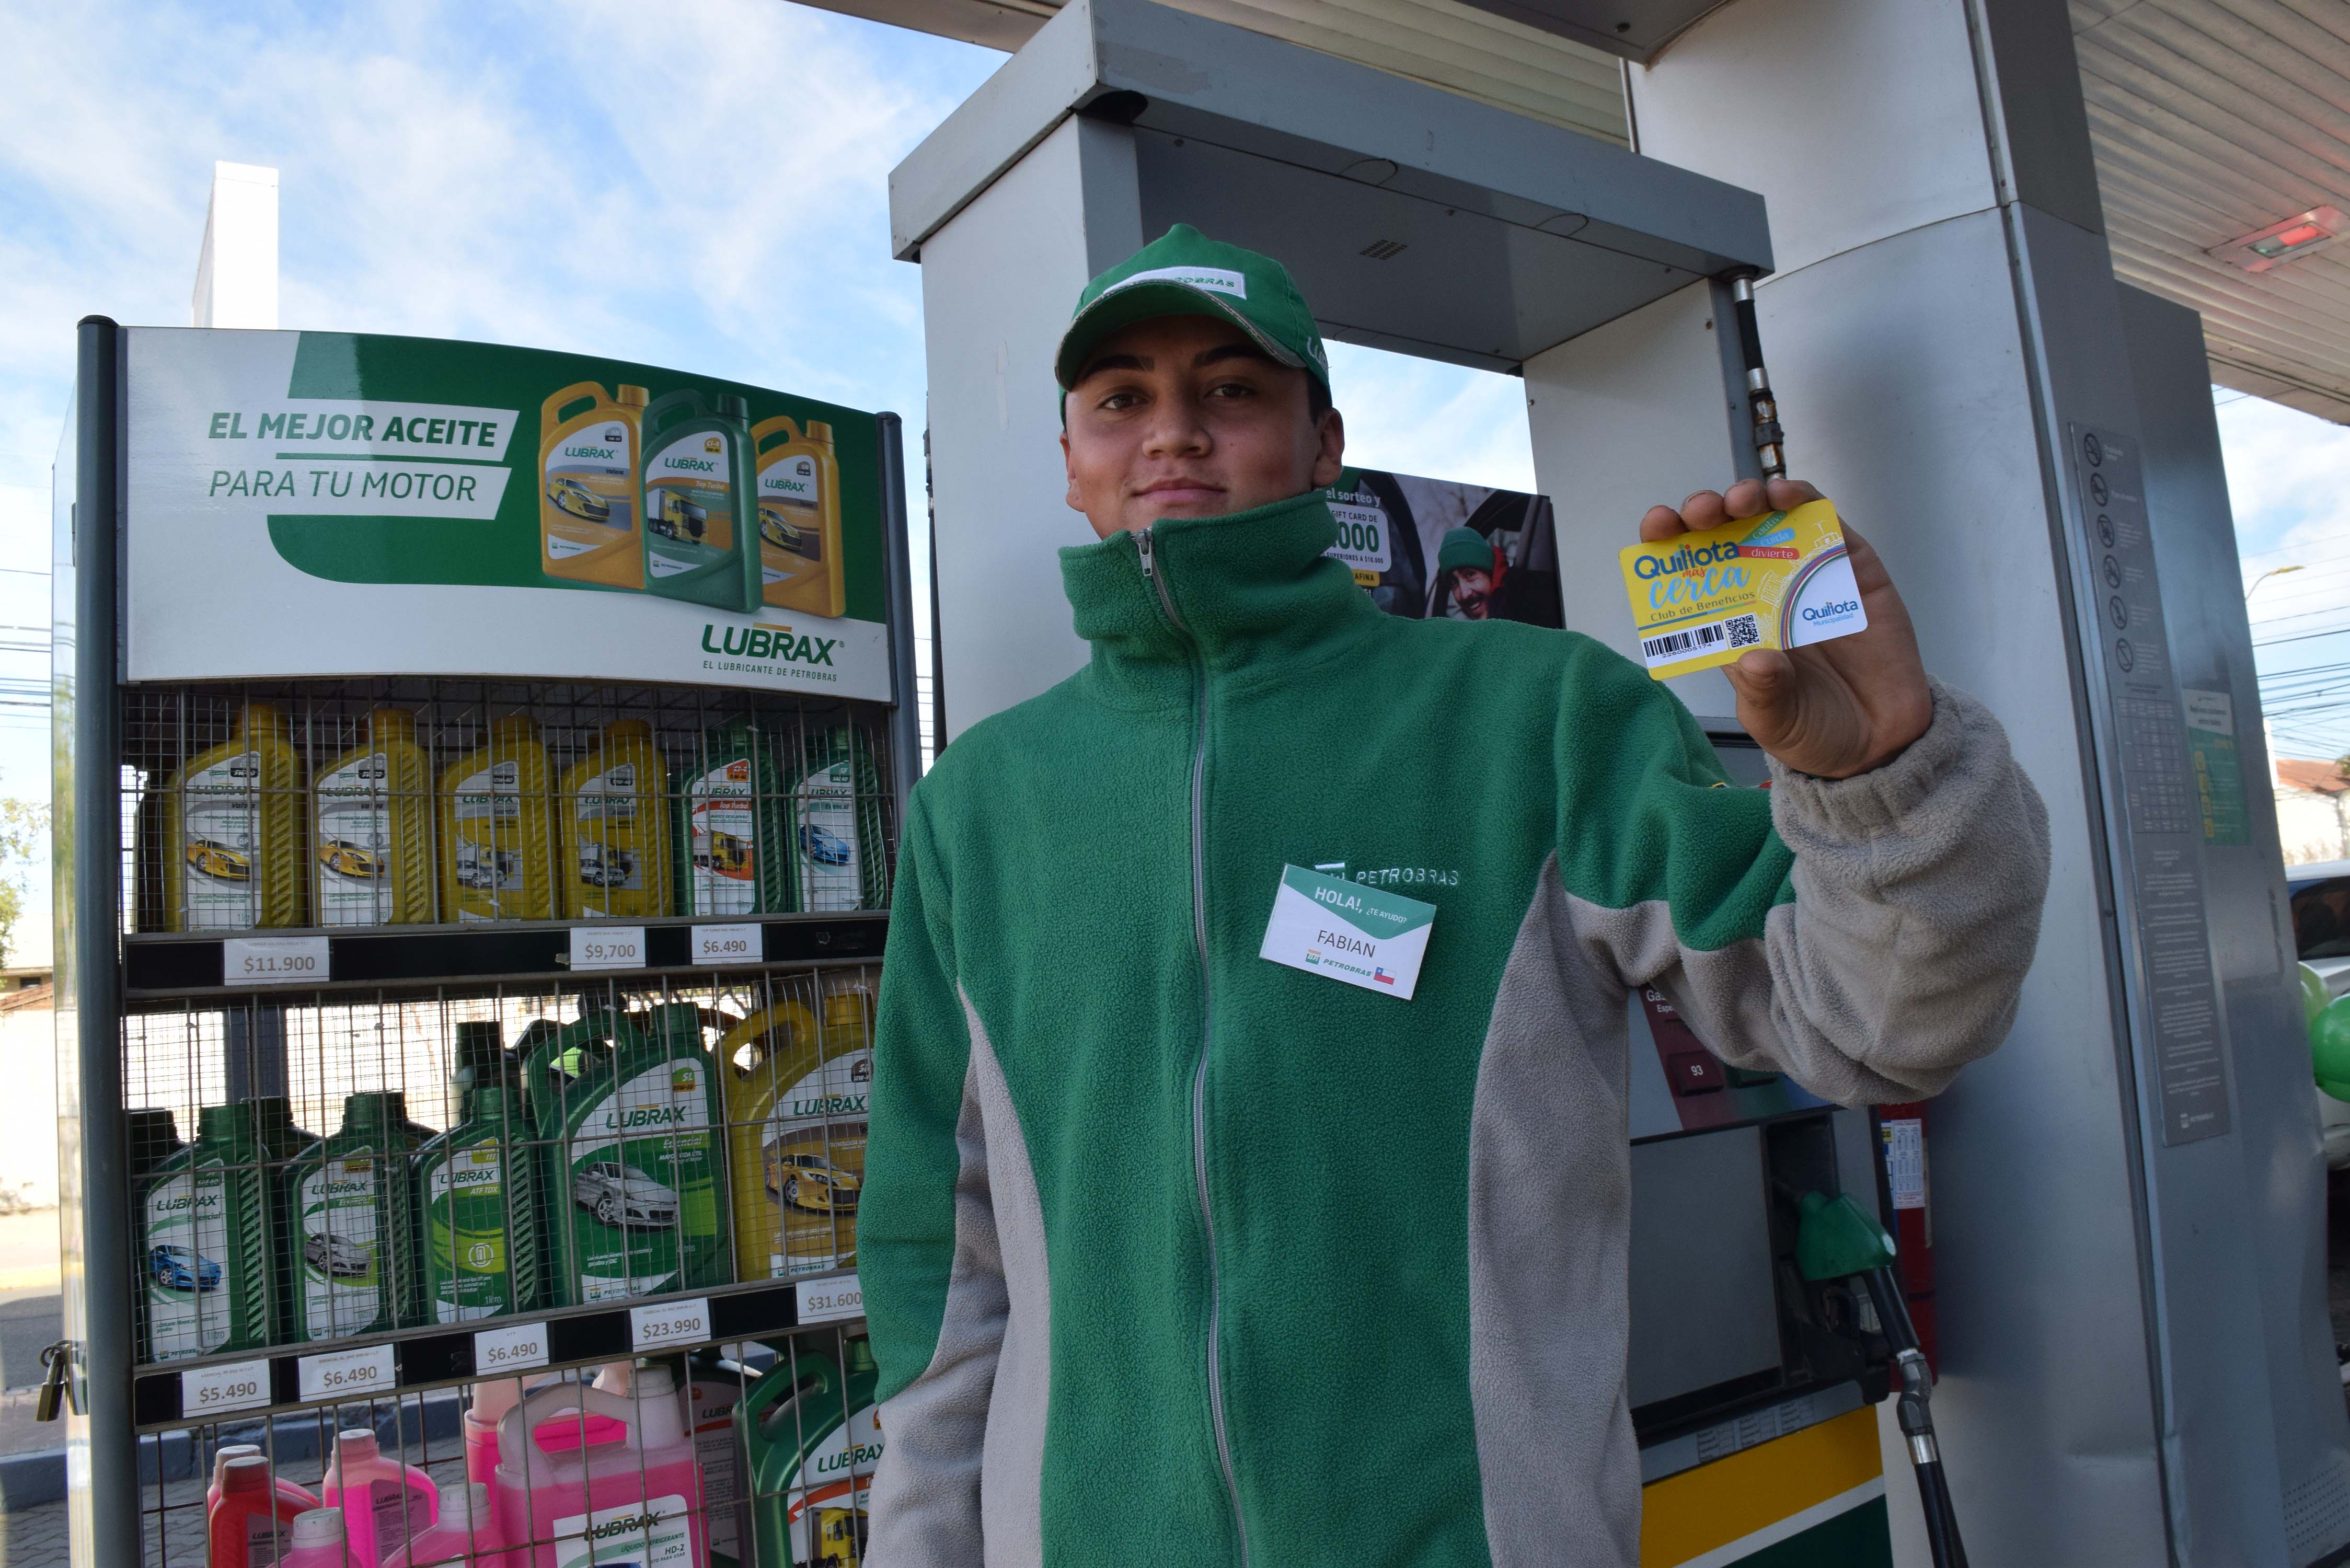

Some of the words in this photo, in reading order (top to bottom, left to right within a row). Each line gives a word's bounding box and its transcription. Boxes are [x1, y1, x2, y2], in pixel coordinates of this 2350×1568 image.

[209, 413, 247, 439] EL
[257, 413, 373, 441] MEJOR
[382, 417, 497, 447] ACEITE
[565, 447, 615, 459] LUBRAX
[665, 458, 715, 472] LUBRAX
[209, 470, 296, 498] PARA
[310, 470, 352, 498] TU
[362, 472, 477, 502] MOTOR
[696, 480, 706, 489] Top
[765, 479, 805, 492] LUBRAX
[1338, 490, 1372, 503] sorteo
[1374, 496, 1380, 508] y
[1349, 512, 1367, 521] CARD
[1760, 532, 1789, 546] cuida
[1634, 541, 1740, 580] Quillota
[1752, 548, 1793, 559] divierte
[1683, 568, 1708, 578] más
[1649, 566, 1750, 610] cerca
[1651, 610, 1675, 622] Club
[1680, 606, 1692, 615] de
[1697, 592, 1755, 611] Beneficios
[1802, 600, 1859, 621] Quillota
[702, 624, 836, 666] LUBRAX
[703, 661, 713, 669] EL
[718, 662, 773, 674] LUBRICANTE
[777, 667, 787, 676] DE
[790, 669, 837, 682] PETROBRAS
[1357, 868, 1459, 885] PETROBRAS
[1315, 886, 1363, 914] HOLA!,
[1366, 908, 1378, 916] ¿TE
[1379, 910, 1407, 924] AYUDO?
[585, 943, 636, 960] $9,700
[704, 940, 747, 954] $6.490
[1317, 930, 1376, 958] FABIAN
[244, 956, 315, 974] $11.900
[1323, 959, 1373, 977] PETROBRAS
[1691, 1065, 1703, 1076] 93
[794, 1096, 866, 1116] LUBRAX
[606, 1106, 686, 1129] LUBRAX
[188, 1212, 221, 1221] Eencial
[790, 1264, 824, 1272] PETROBRAS
[808, 1292, 862, 1312] $31.600
[643, 1318, 700, 1340] $23.990
[488, 1342, 537, 1363] $6.490
[324, 1366, 377, 1388] $6.490
[200, 1381, 257, 1404] $5.490
[647, 1532, 685, 1546] EFRIGERANTE
[665, 1543, 685, 1555] HD-2
